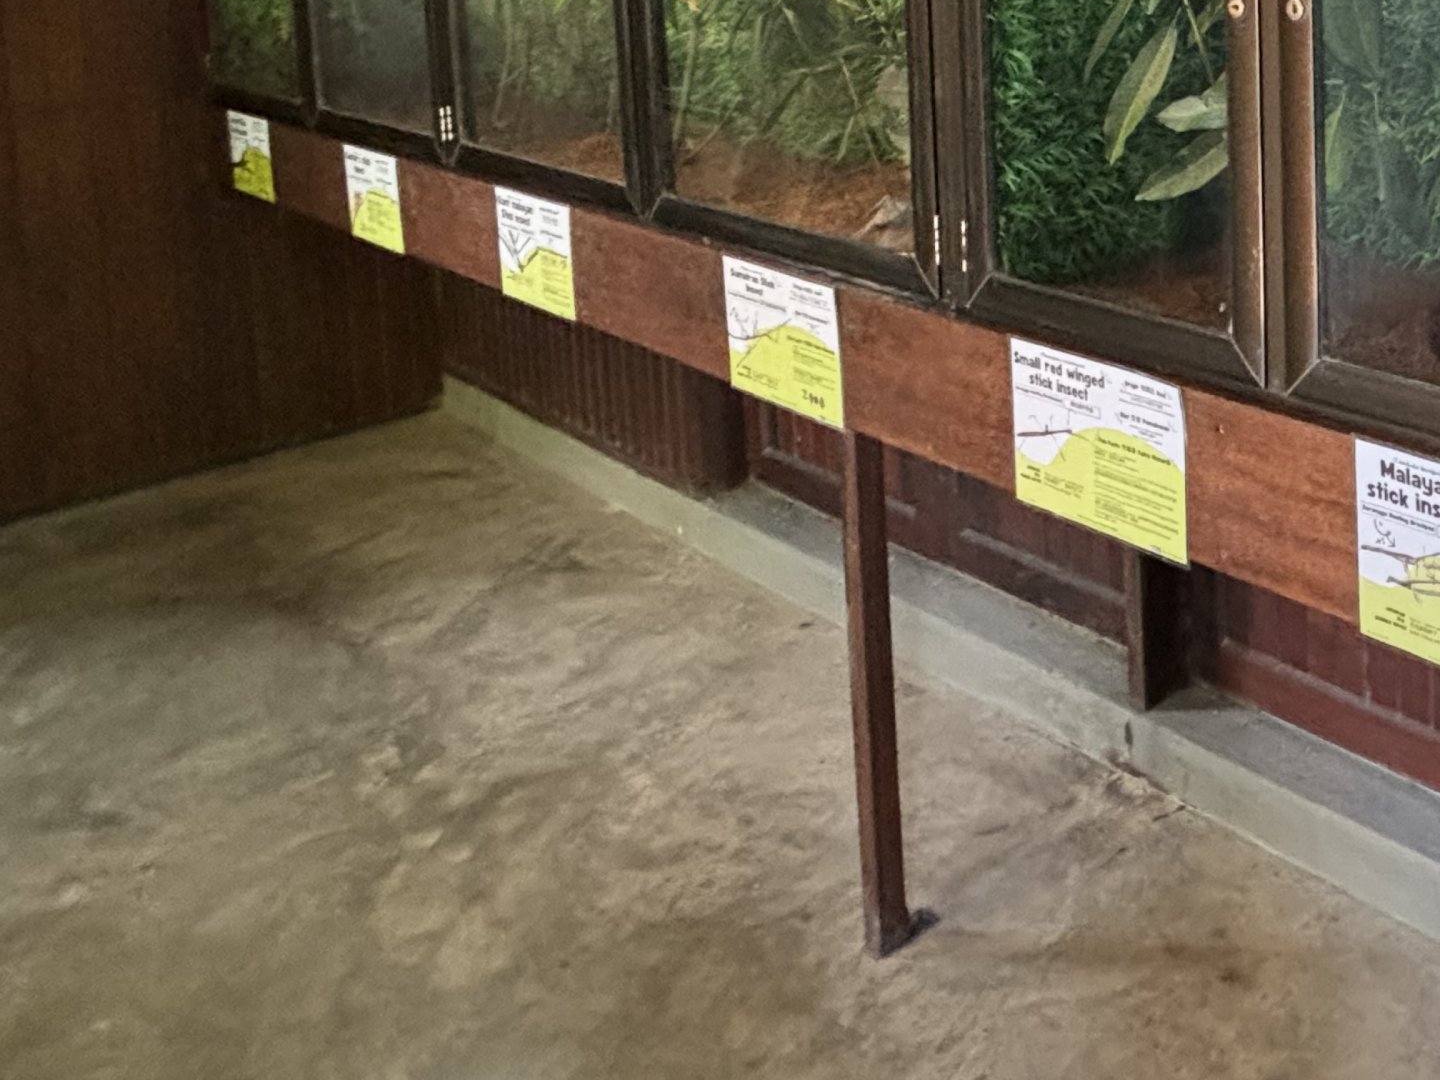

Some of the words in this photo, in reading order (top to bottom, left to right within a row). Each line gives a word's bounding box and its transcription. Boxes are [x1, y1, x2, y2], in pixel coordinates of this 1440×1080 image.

[1014, 351, 1041, 369] Small
[1045, 362, 1062, 376] red
[1066, 367, 1105, 389] winged
[1029, 373, 1053, 390] stick
[1056, 379, 1088, 401] insect
[1367, 481, 1409, 508] stick
